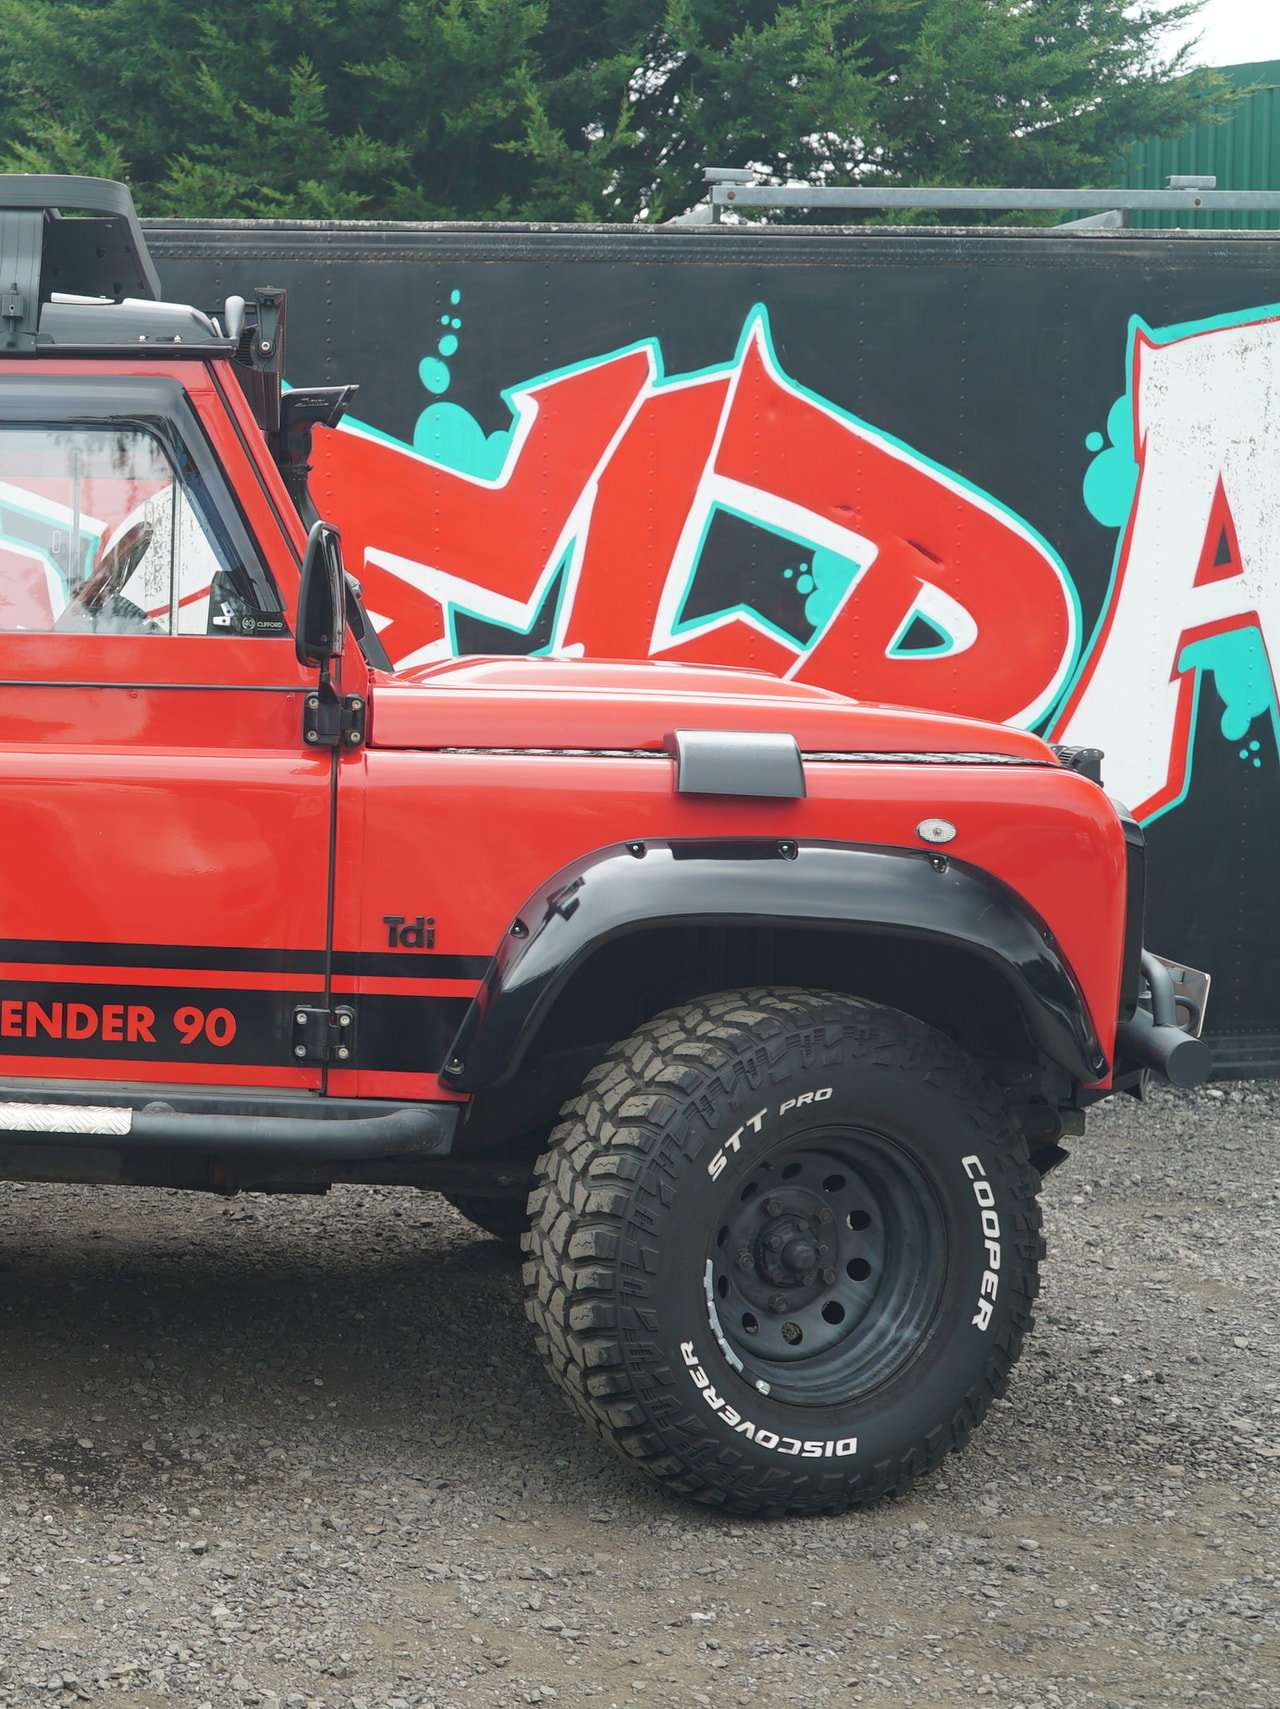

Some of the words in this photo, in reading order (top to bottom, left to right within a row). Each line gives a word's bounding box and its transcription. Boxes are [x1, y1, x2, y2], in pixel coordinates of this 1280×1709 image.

[382, 916, 436, 949] Tdi
[173, 1005, 237, 1047] 90
[707, 1107, 768, 1182] STT
[779, 1087, 833, 1116] PRO
[961, 1154, 1001, 1332] COOPER
[680, 1340, 858, 1458] DISCOVERER
